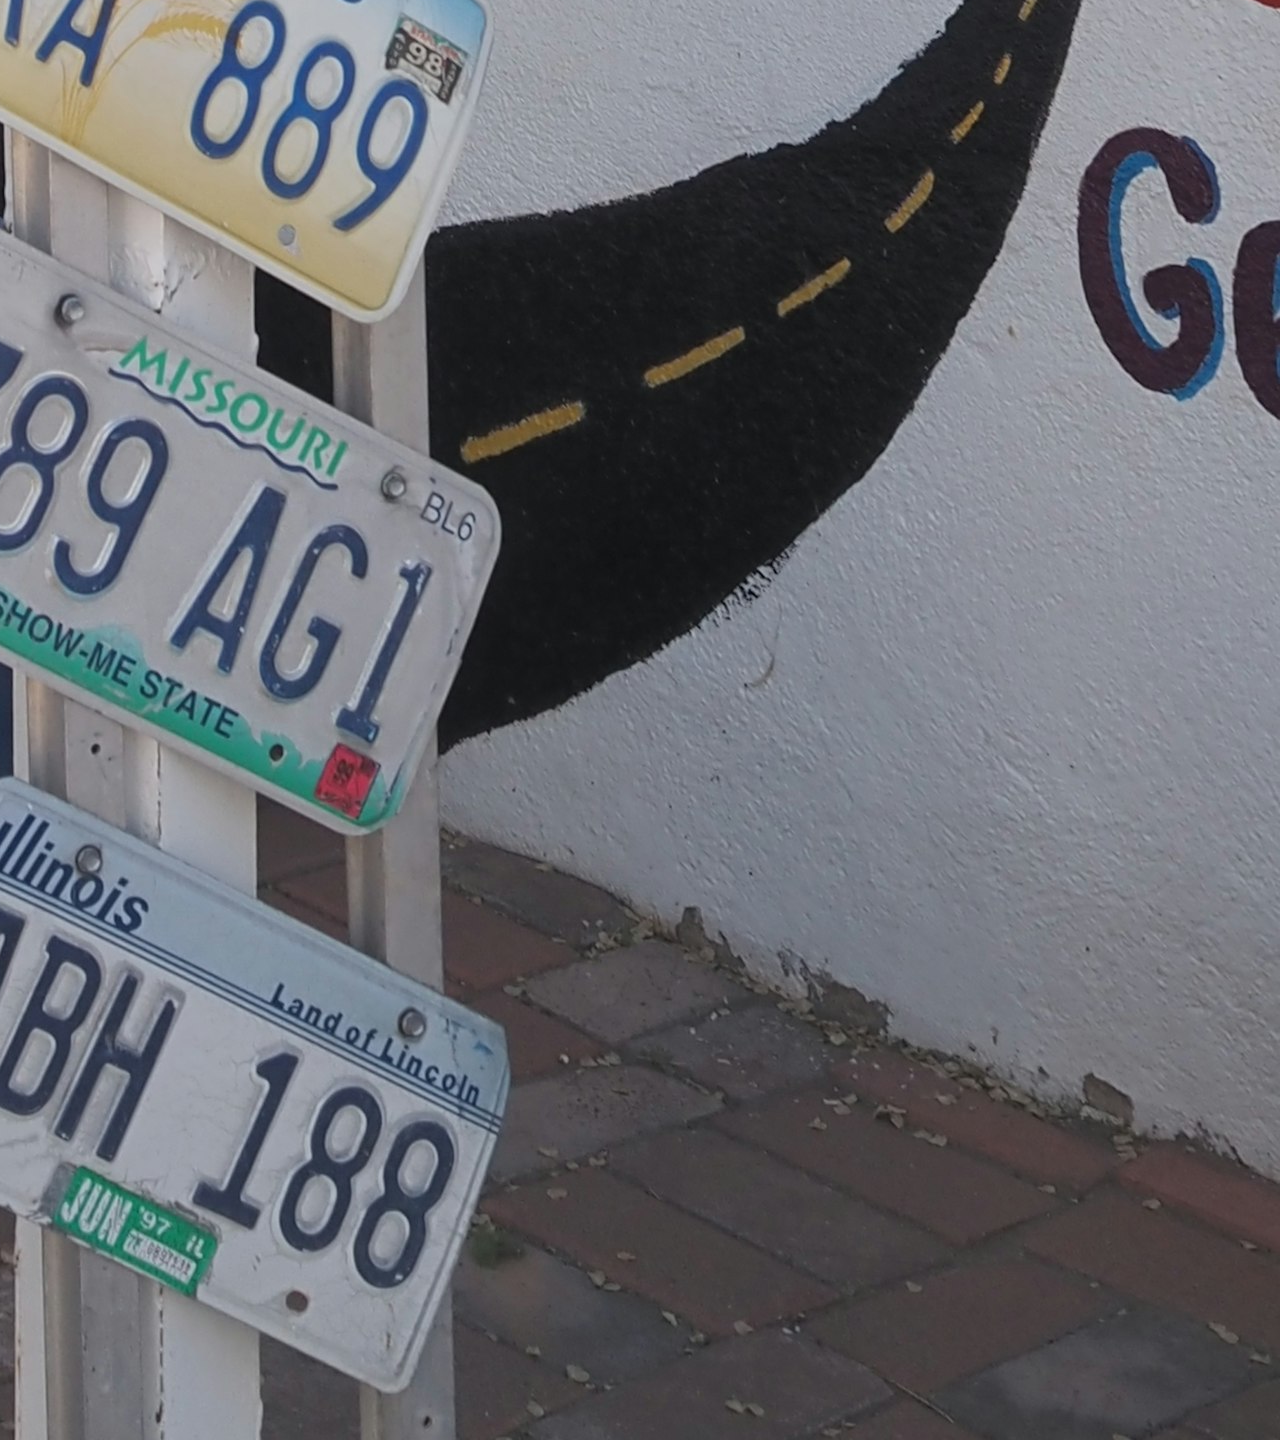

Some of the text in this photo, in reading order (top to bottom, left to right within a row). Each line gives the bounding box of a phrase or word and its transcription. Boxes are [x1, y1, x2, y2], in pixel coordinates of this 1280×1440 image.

[405, 41, 443, 78] 98
[119, 336, 349, 479] MISSOURI
[419, 490, 477, 543] BL6
[171, 484, 433, 745] AG1
[139, 668, 239, 739] STATE
[271, 982, 482, 1108] Land of Lincoln
[60, 1178, 133, 1246] JUN
[192, 1051, 457, 1289] 188
